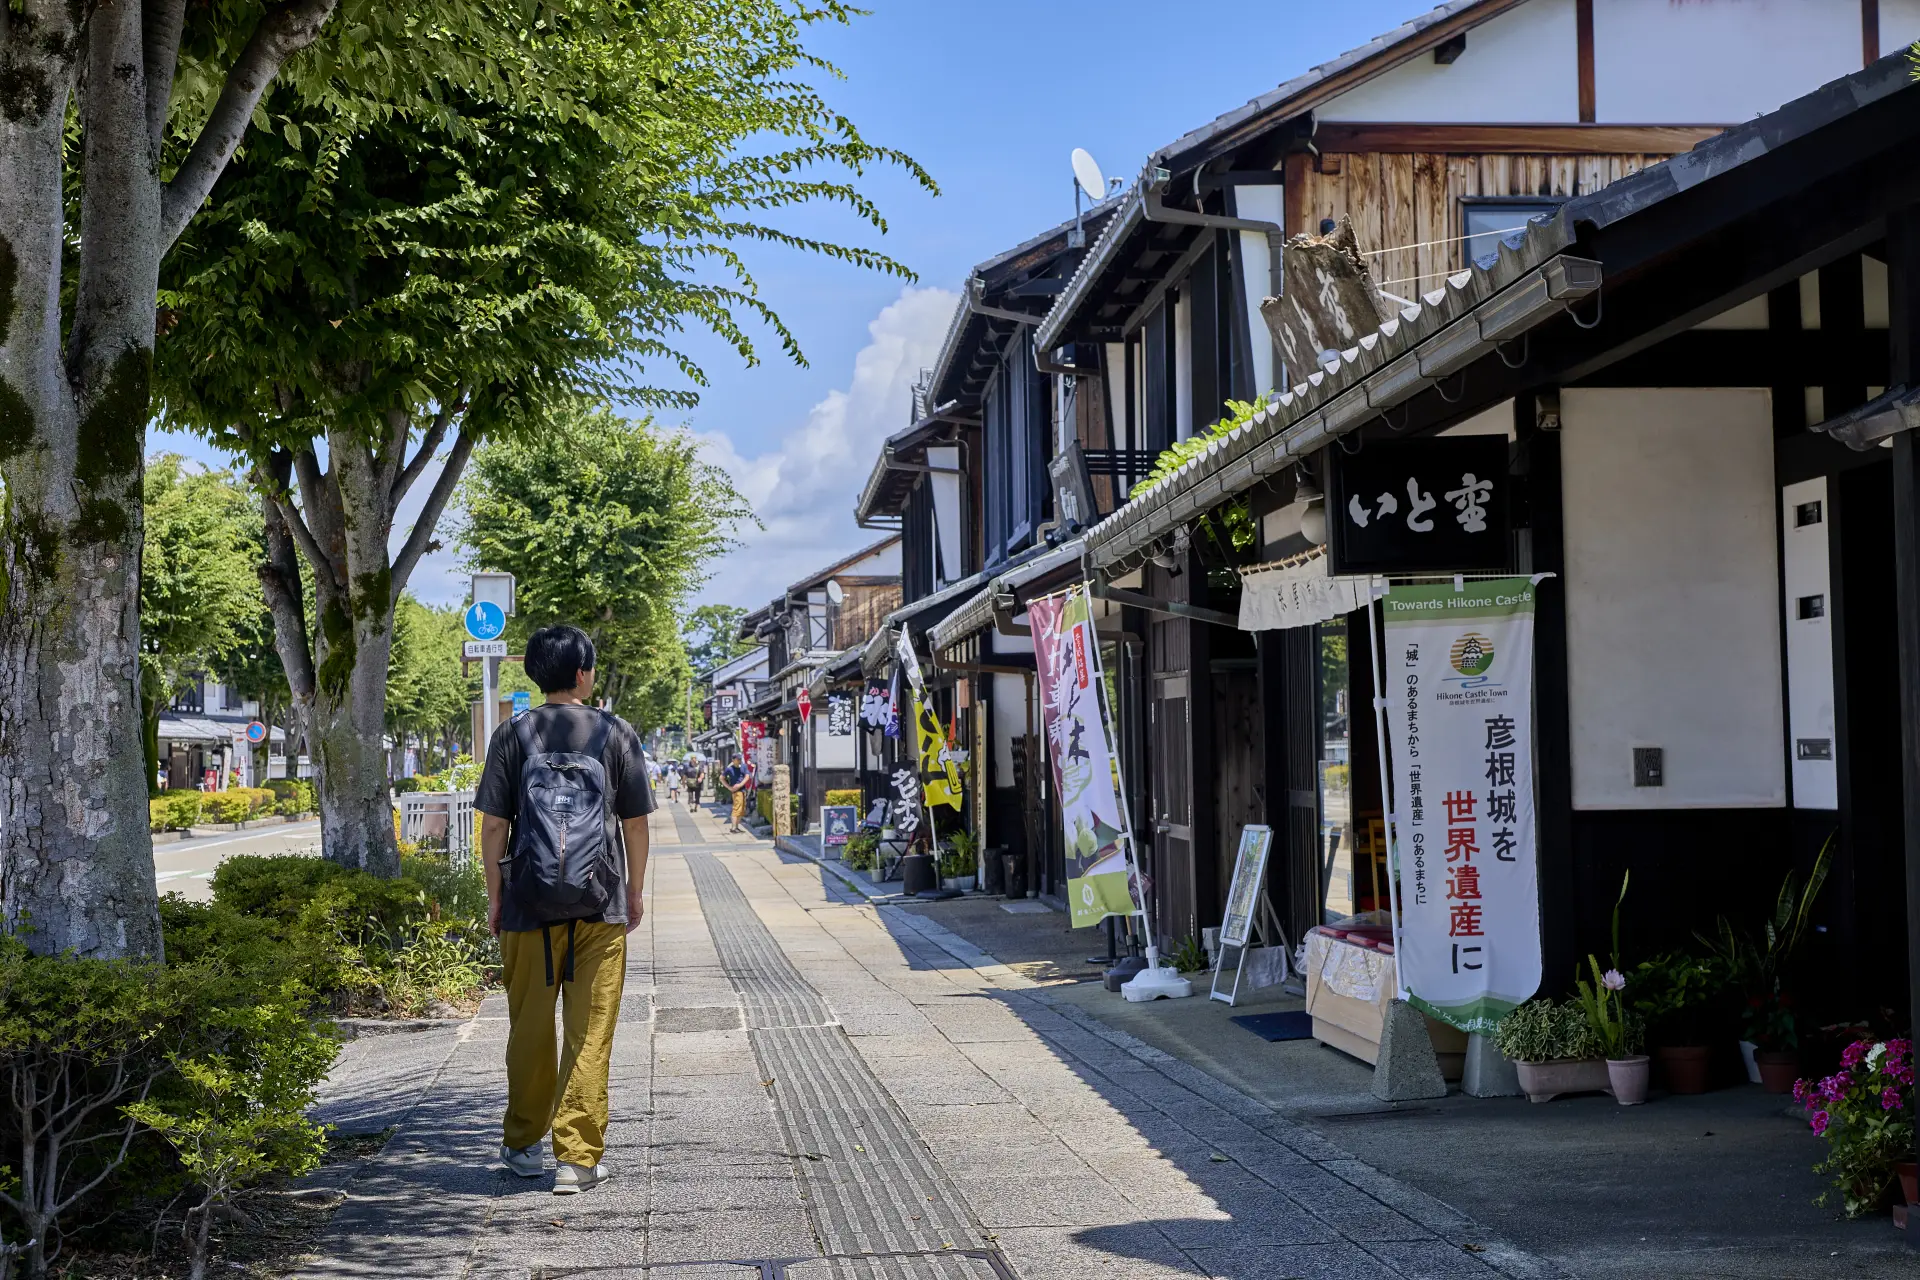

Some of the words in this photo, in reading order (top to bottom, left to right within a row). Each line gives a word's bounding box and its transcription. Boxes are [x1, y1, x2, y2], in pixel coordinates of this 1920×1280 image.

[1390, 598, 1443, 611] Towards
[1447, 596, 1492, 608] Hikone
[1496, 592, 1532, 606] Castle
[724, 698, 731, 706] P
[1436, 692, 1463, 701] Hikone
[1465, 689, 1488, 699] Castle
[1489, 689, 1508, 697] Town
[890, 768, 920, 832] タピオカ
[1485, 714, 1517, 862] 彦根城を
[1442, 790, 1485, 974] 世界遺産に
